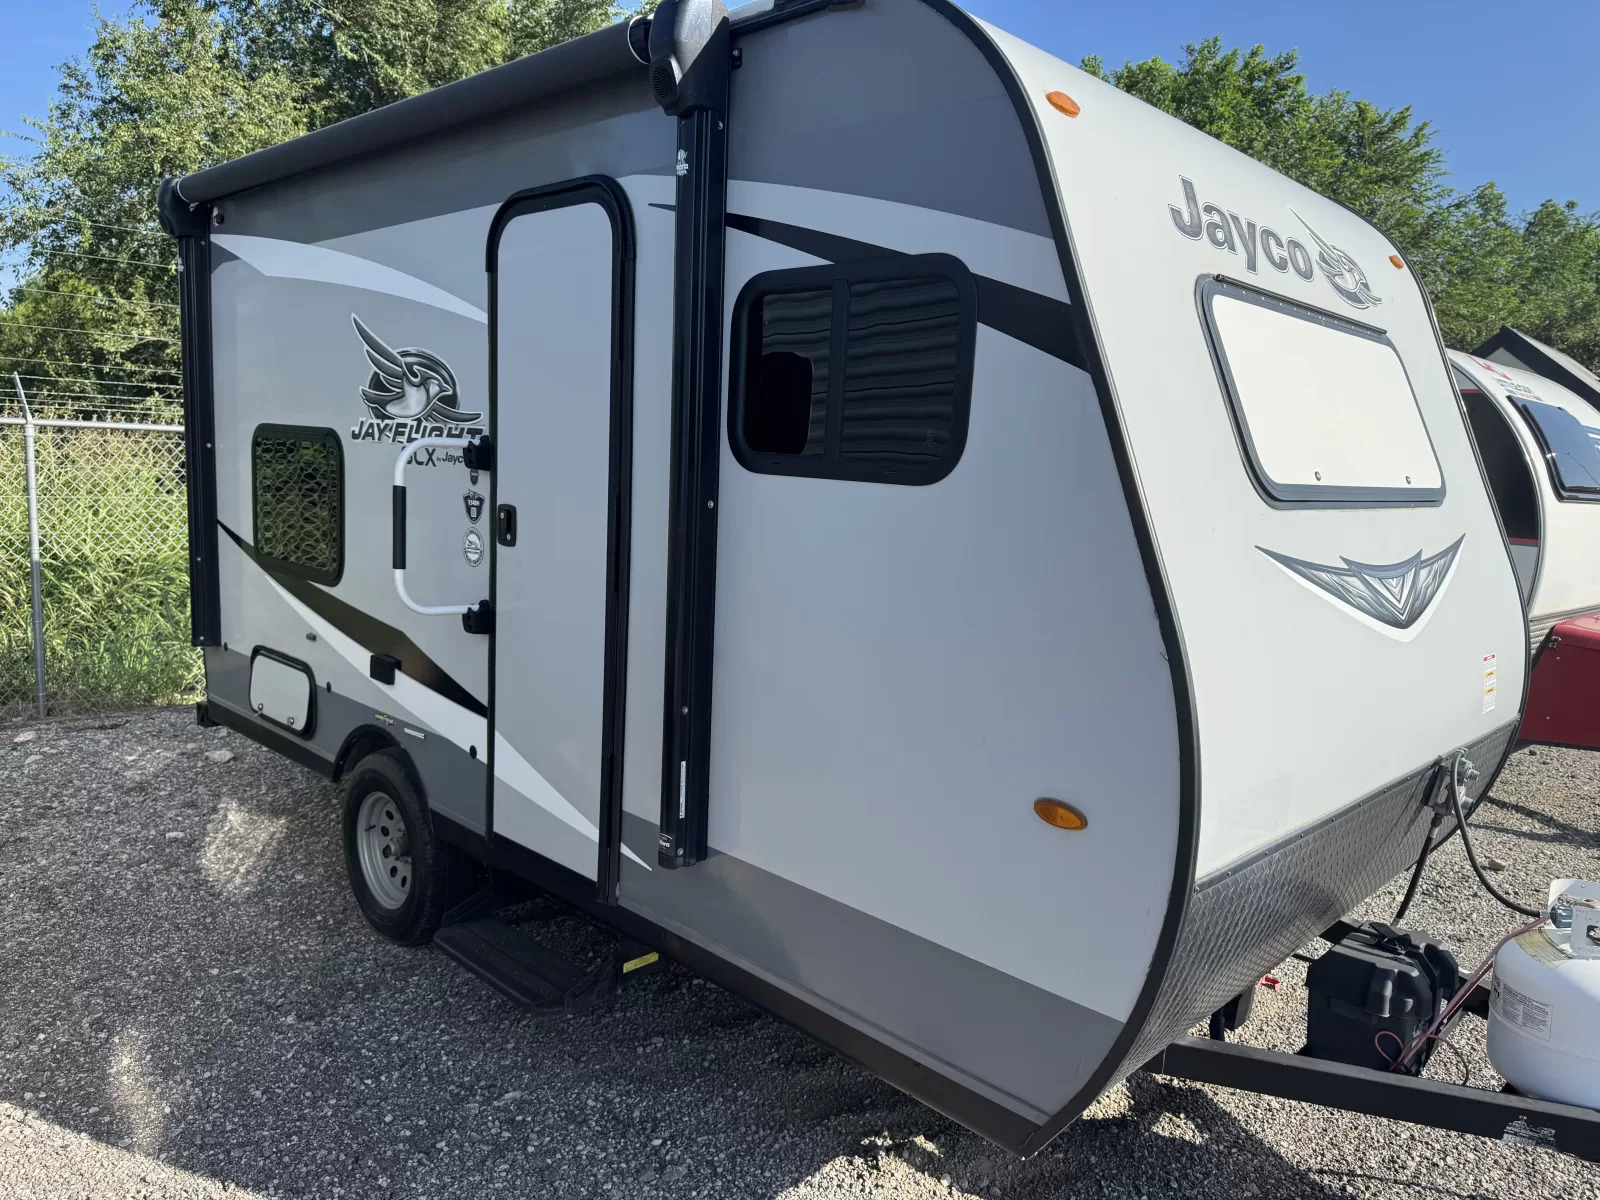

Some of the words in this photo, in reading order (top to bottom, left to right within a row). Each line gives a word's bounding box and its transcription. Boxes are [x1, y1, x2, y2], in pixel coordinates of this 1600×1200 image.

[1168, 175, 1314, 282] Jayco
[351, 417, 391, 442] JAY
[442, 451, 465, 466] Jayc
